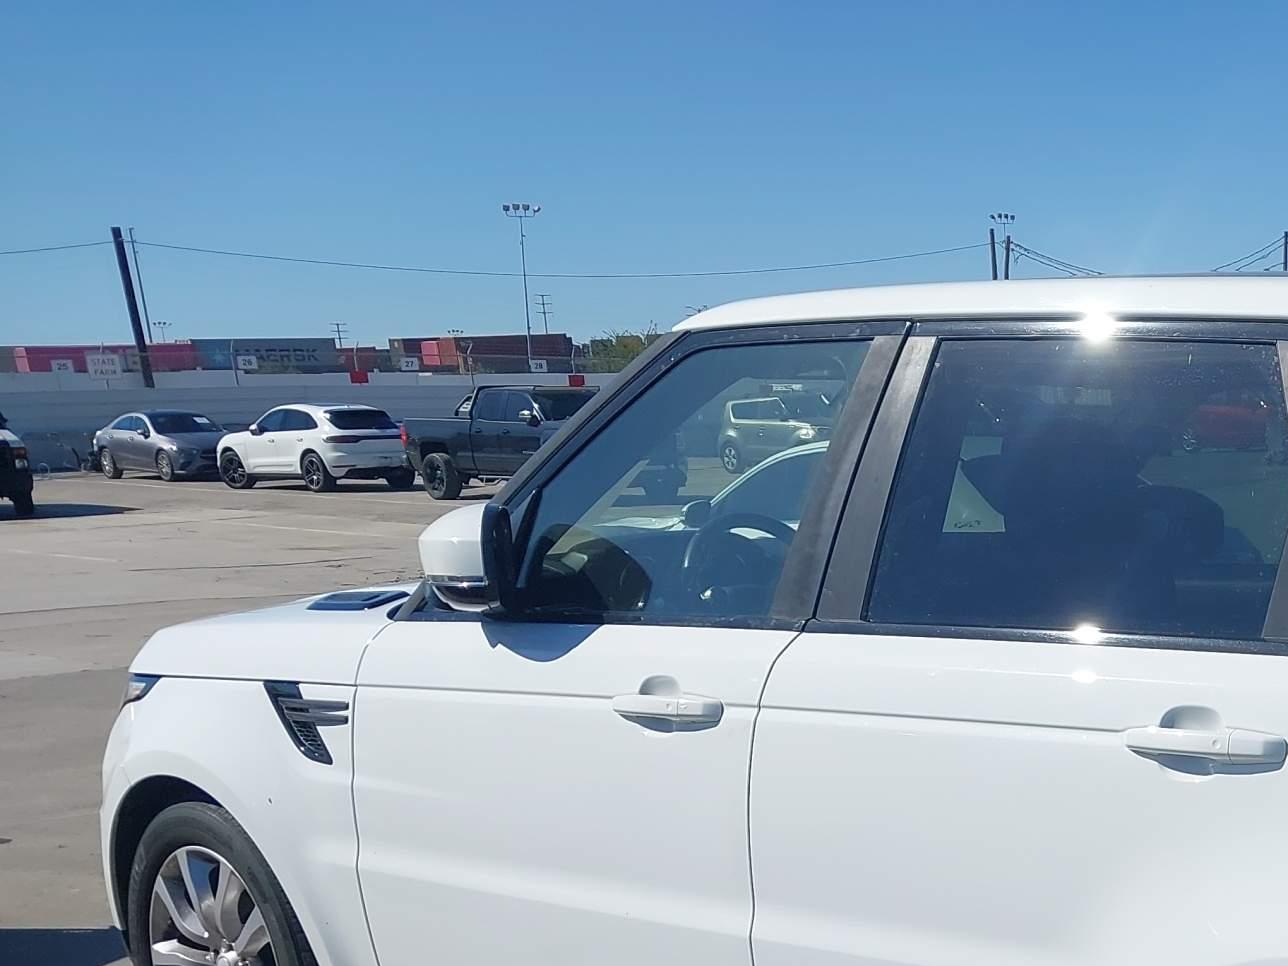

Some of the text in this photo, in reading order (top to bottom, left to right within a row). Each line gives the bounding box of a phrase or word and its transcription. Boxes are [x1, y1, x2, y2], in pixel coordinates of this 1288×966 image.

[92, 358, 115, 366] STATE
[241, 358, 253, 367] 26
[404, 360, 414, 368] 27
[534, 361, 543, 369] 28
[56, 362, 69, 371] 25
